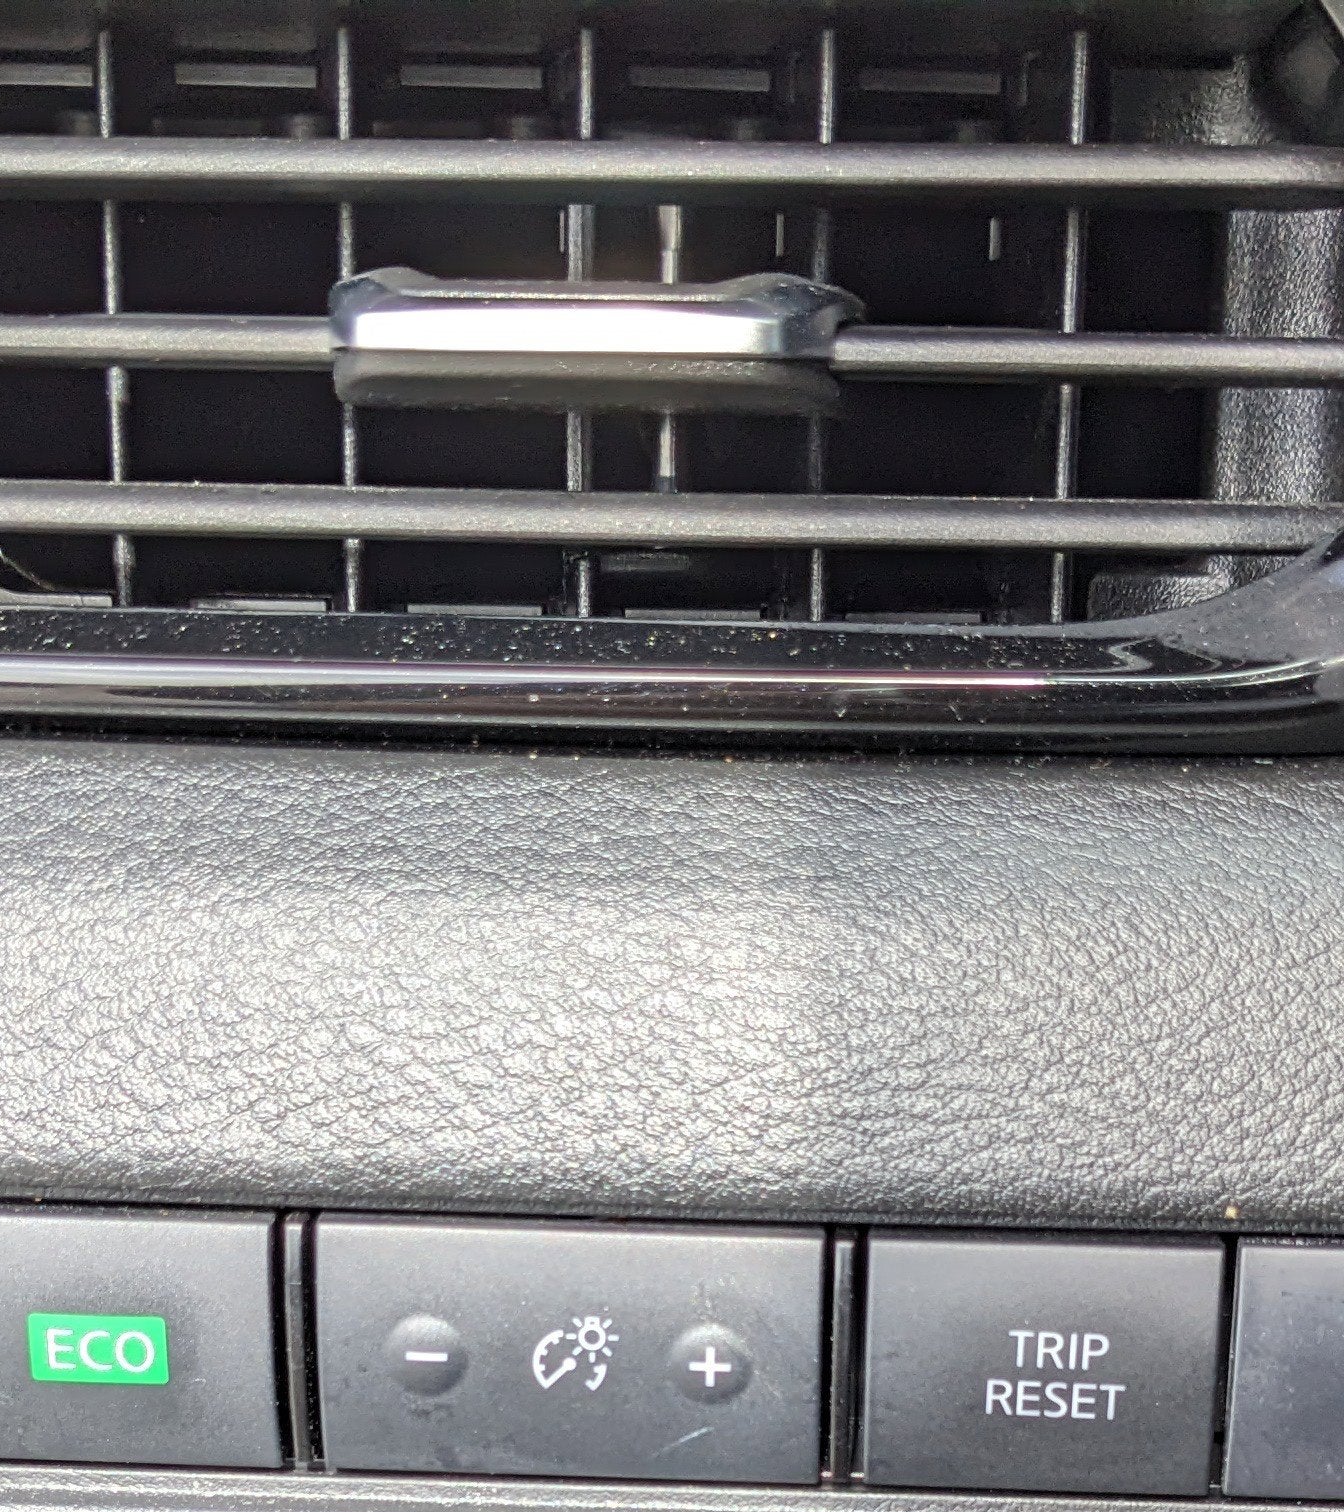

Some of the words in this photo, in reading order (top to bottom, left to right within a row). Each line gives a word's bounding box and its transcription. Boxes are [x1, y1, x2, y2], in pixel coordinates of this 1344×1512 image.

[45, 1327, 156, 1374] ECO
[1007, 1328, 1111, 1371] TRIP
[984, 1377, 1128, 1421] RESET
